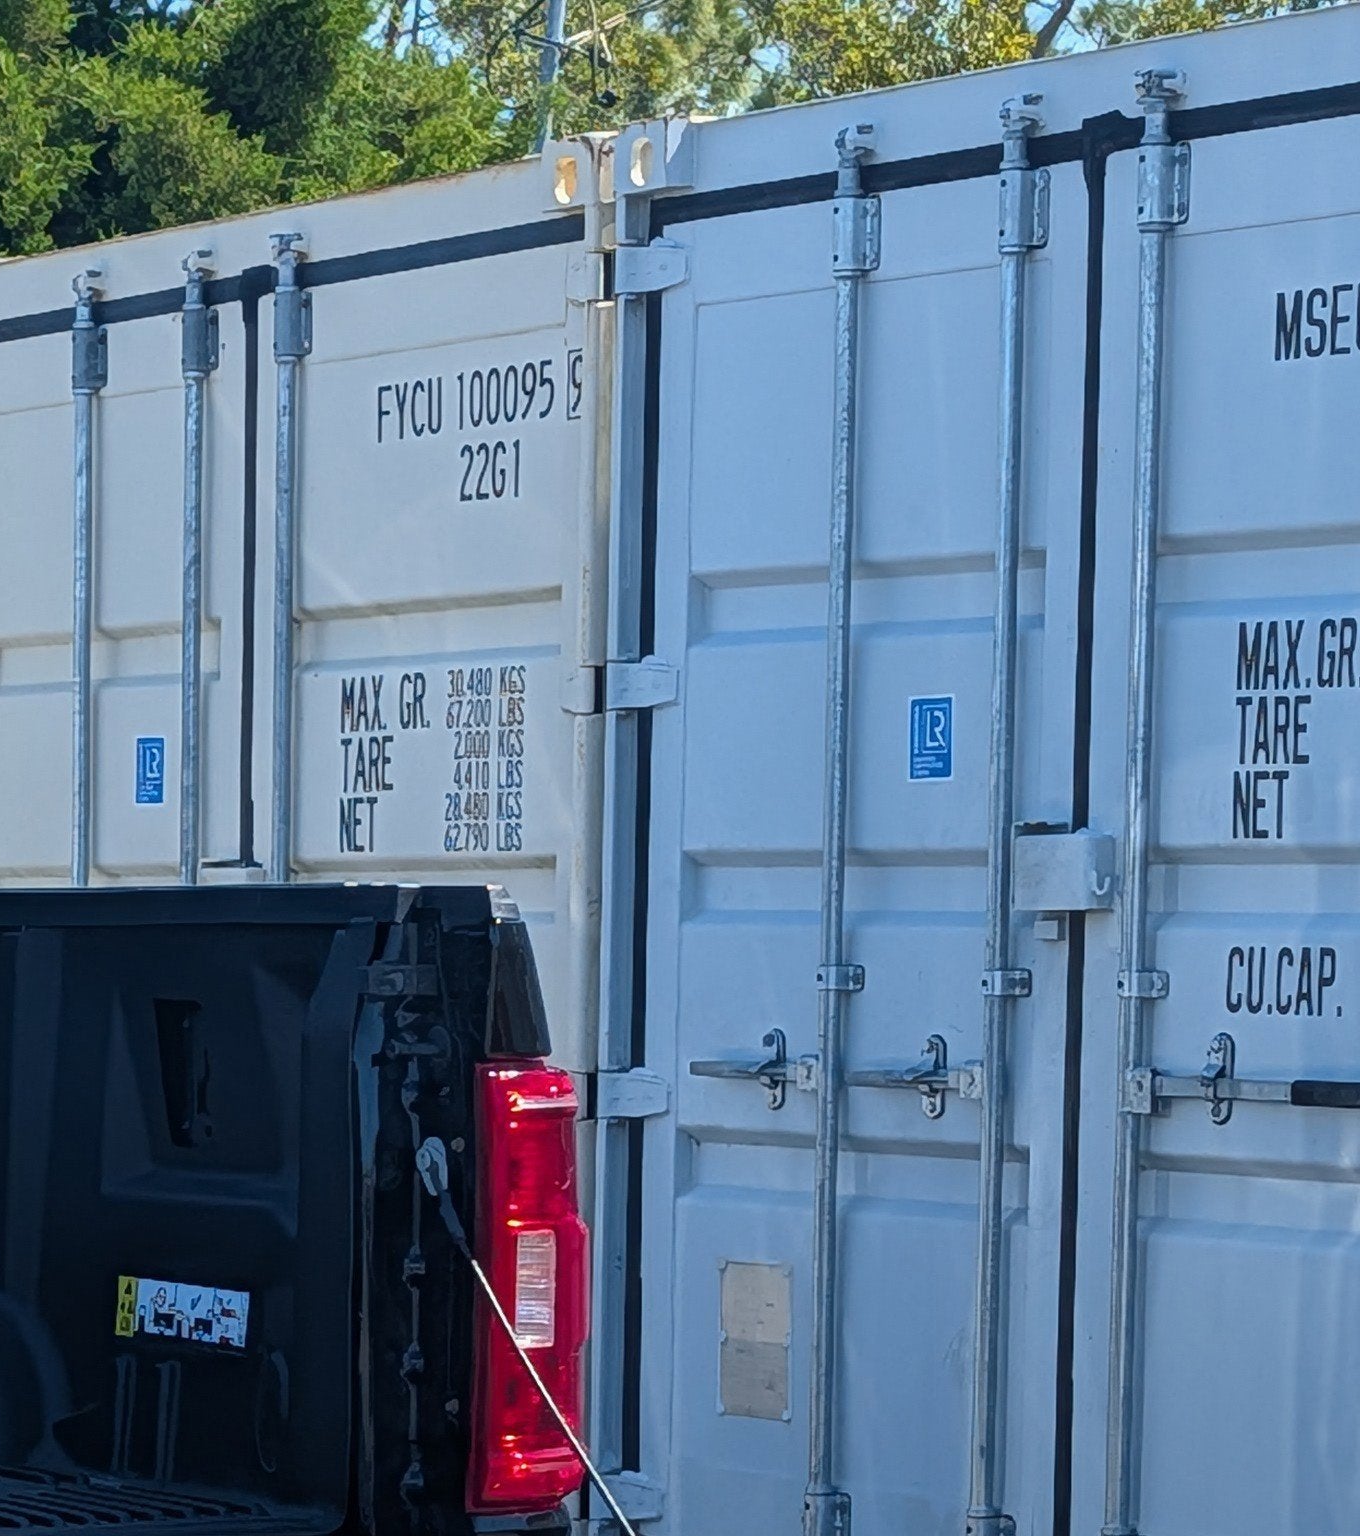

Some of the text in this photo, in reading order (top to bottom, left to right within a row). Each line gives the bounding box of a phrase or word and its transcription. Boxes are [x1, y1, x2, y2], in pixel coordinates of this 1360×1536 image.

[1274, 283, 1360, 361] MSE
[377, 375, 442, 443] FYCU
[457, 359, 555, 430] 100095
[459, 438, 521, 502] 22G1
[399, 672, 430, 729] GR.
[499, 665, 526, 695] KGS
[498, 696, 525, 727] LBS
[1236, 695, 1311, 764] TARE
[340, 735, 394, 793] TARE
[497, 729, 524, 758] KGS
[497, 759, 524, 789] LBS
[339, 796, 378, 853] NET
[496, 791, 523, 820] KGS
[1232, 770, 1290, 839] NET
[496, 823, 523, 852] LBS
[1226, 946, 1342, 1017] CU.CAP.
